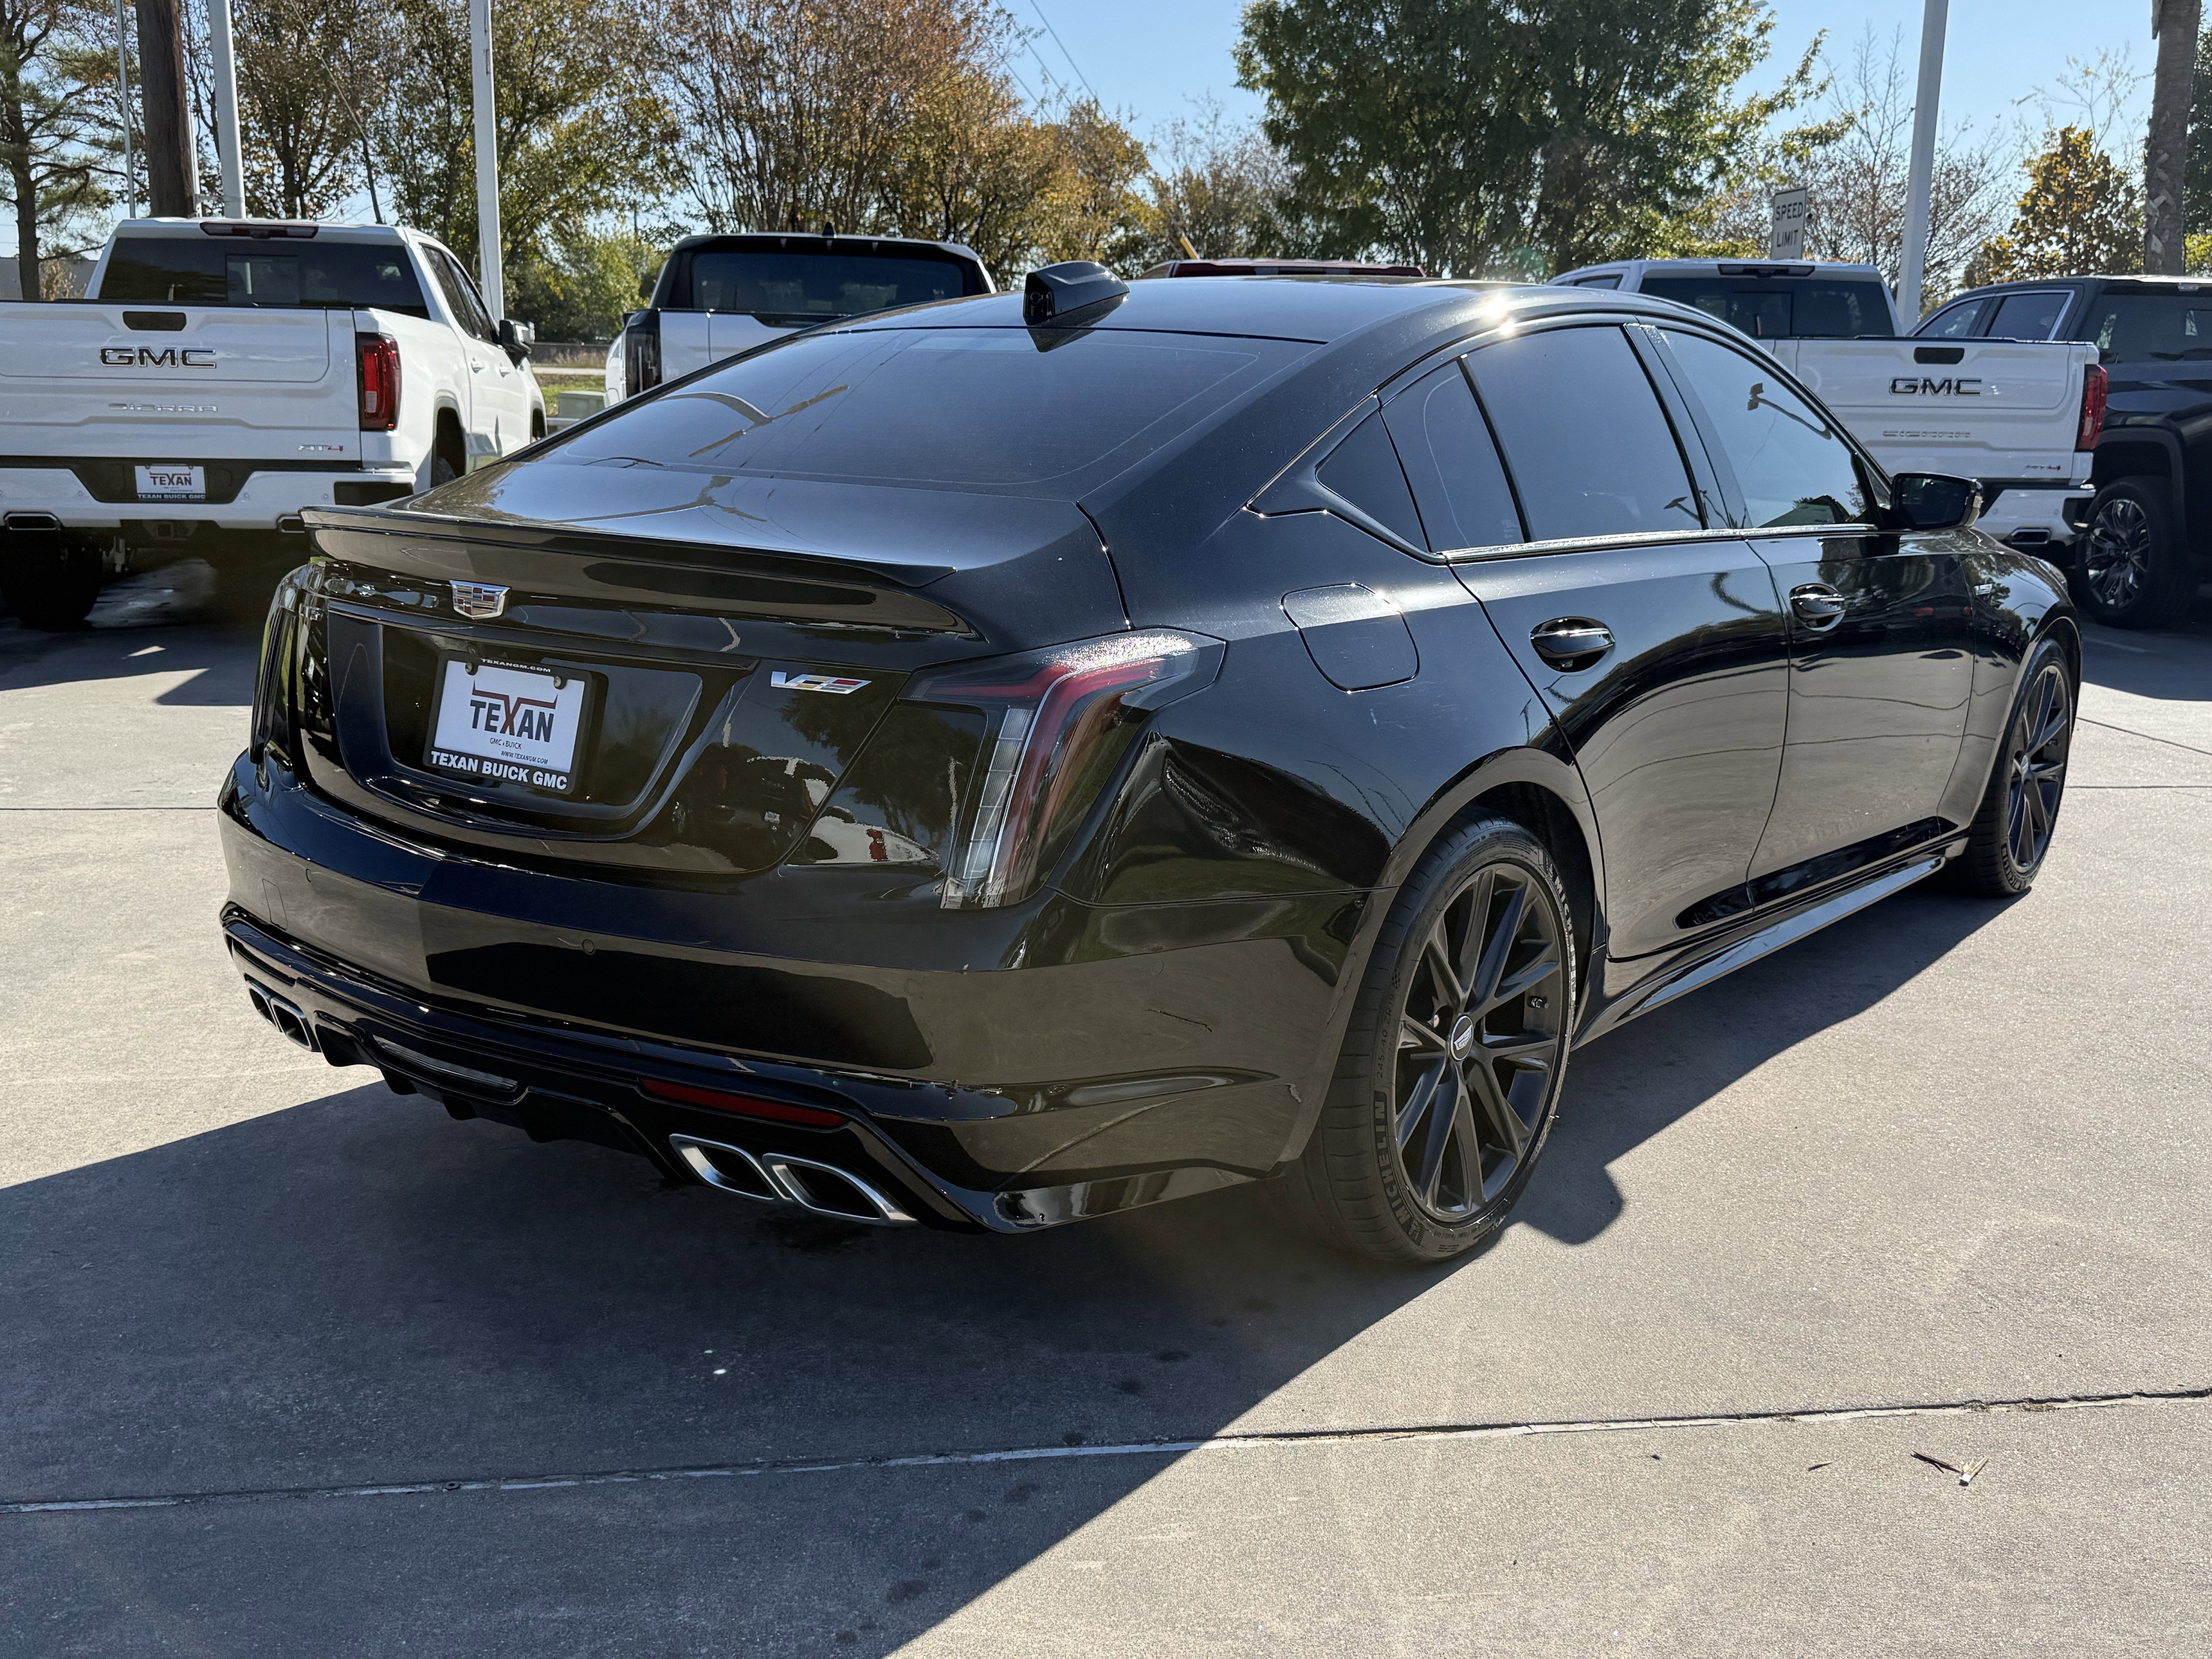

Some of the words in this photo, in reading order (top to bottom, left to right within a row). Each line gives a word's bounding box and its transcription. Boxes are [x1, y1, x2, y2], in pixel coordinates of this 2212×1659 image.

[1776, 202, 1803, 221] SPEED
[1777, 229, 1799, 248] LIMIT
[100, 346, 216, 369] GMC
[1889, 377, 1982, 397] GMC
[149, 471, 192, 486] TEXAN
[480, 658, 551, 673] TEXANGM.COM
[469, 679, 558, 743] TEXAN
[489, 737, 502, 746] GMC
[505, 740, 522, 750] BUICK
[431, 750, 479, 773] TEXAN
[482, 761, 530, 783] BUICK
[532, 771, 568, 790] GMC
[1376, 1029, 1388, 1079] 245/40
[1374, 1101, 1411, 1225] MICHELIN
